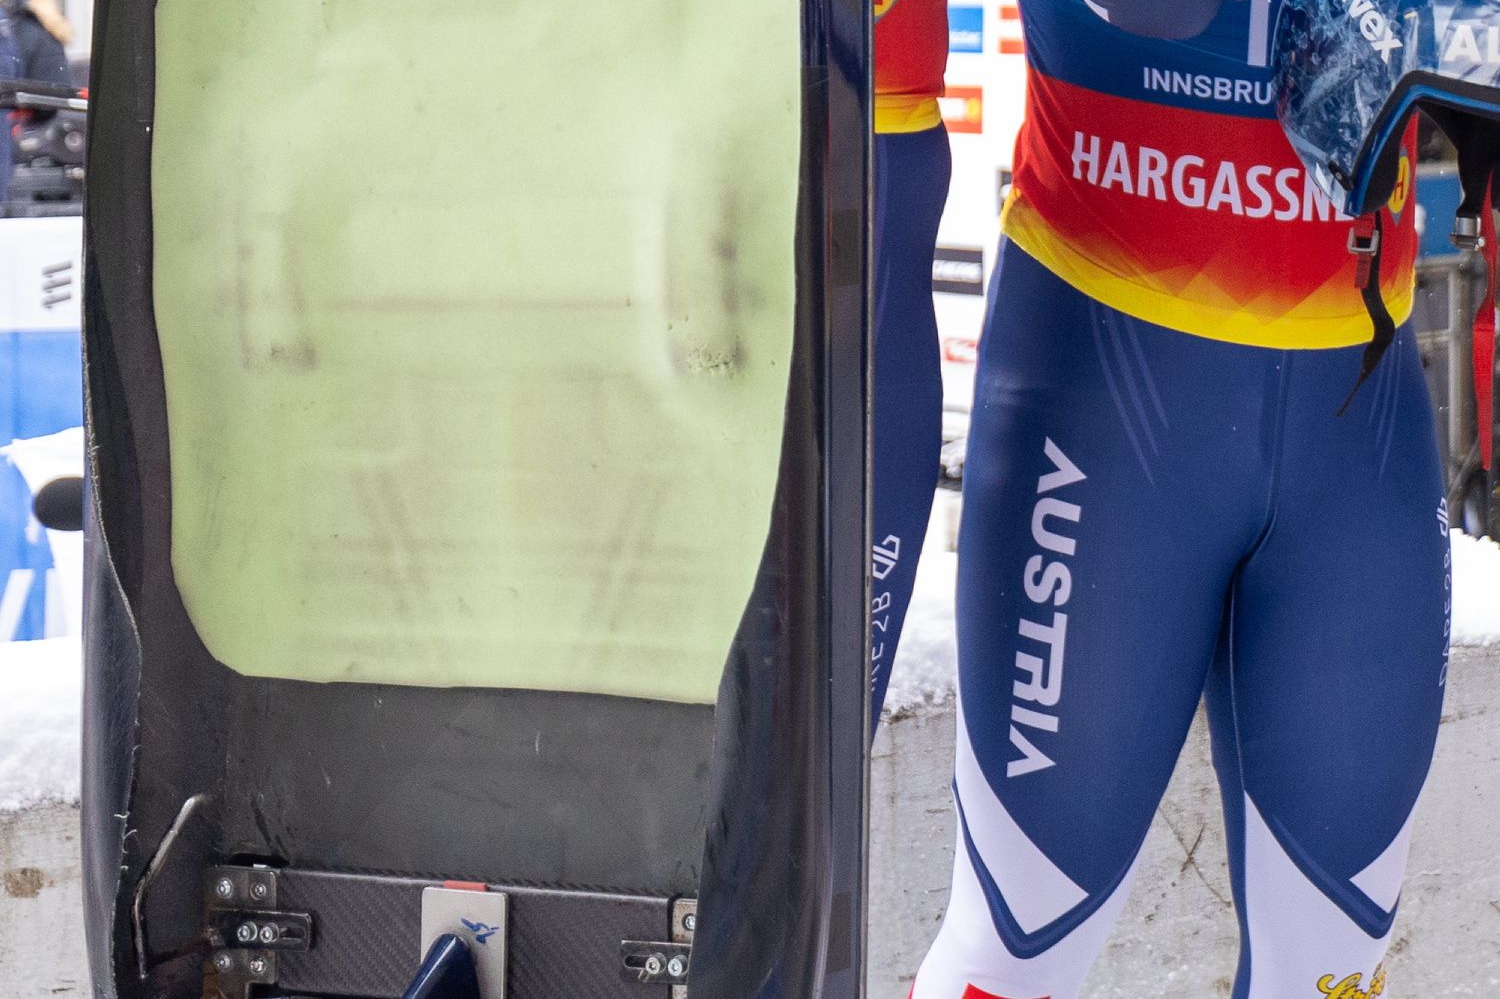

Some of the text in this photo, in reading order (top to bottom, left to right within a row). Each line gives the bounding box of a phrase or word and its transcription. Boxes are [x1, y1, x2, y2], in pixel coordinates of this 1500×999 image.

[1143, 66, 1272, 106] INNSBRU
[1072, 131, 1356, 222] HARGASSN
[1006, 436, 1088, 779] AUSTRIA
